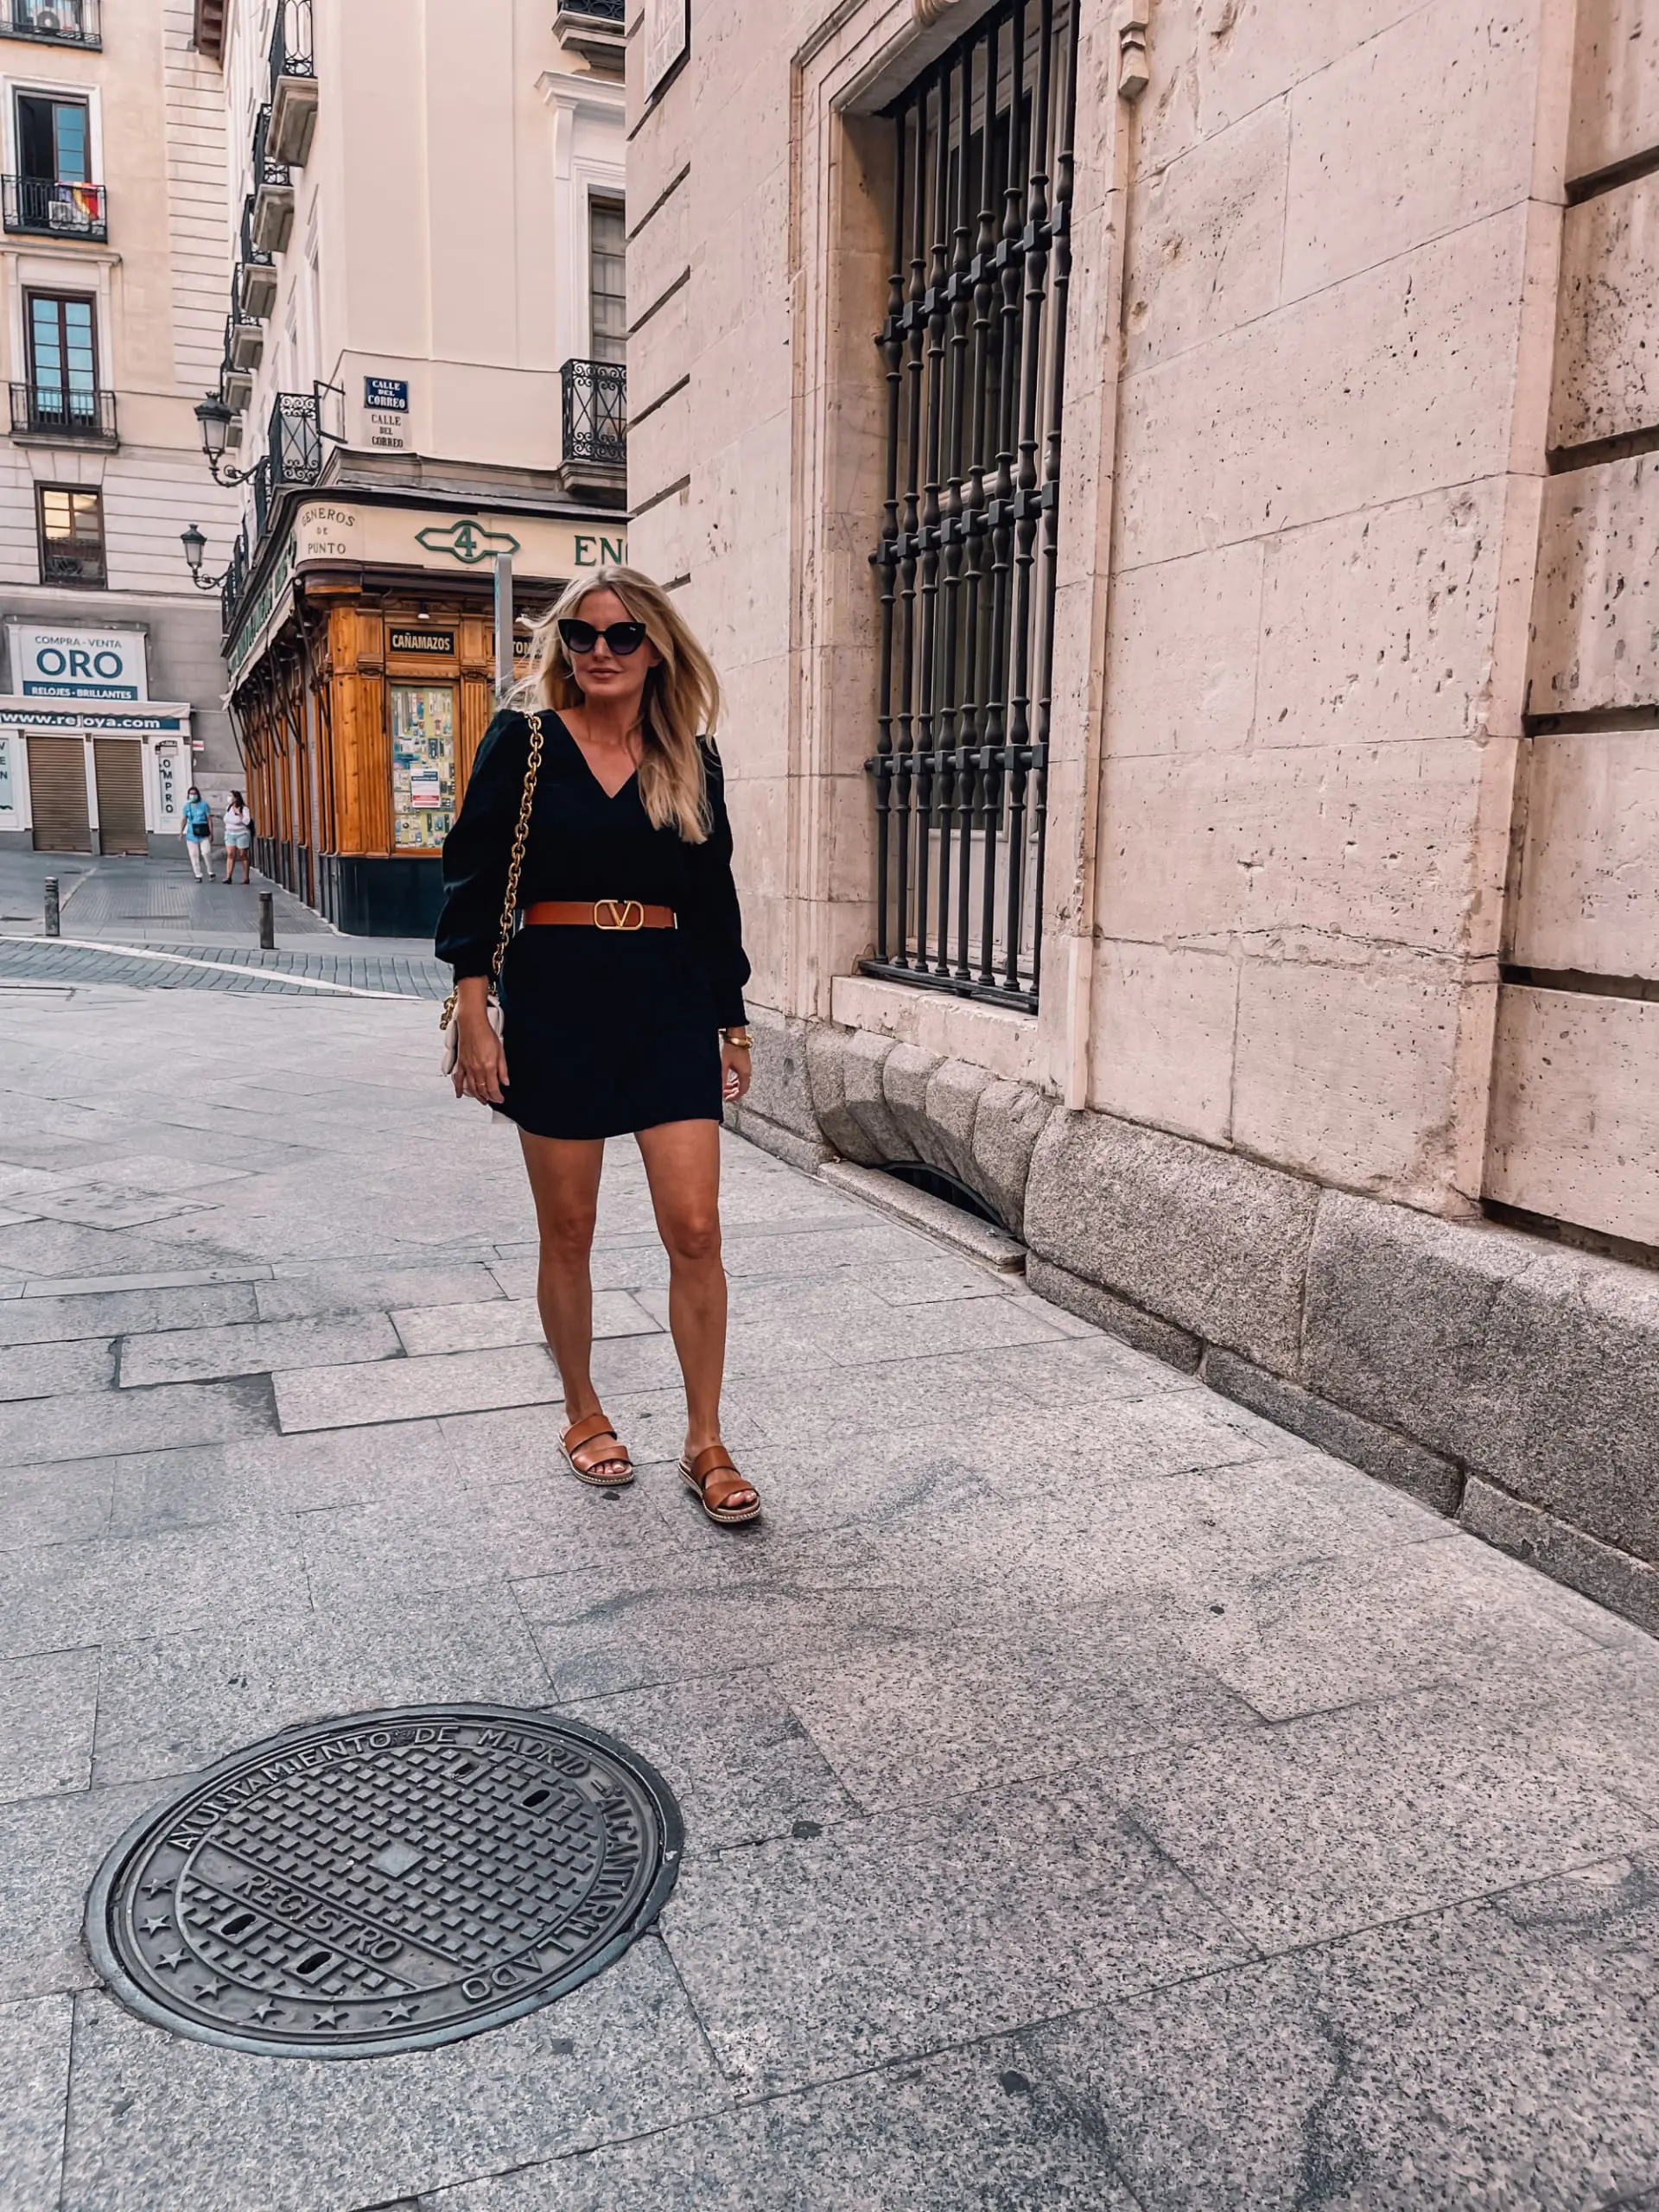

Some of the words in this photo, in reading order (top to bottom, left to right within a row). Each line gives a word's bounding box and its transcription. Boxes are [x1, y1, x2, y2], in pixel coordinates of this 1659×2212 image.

[372, 379, 401, 391] CALLE
[367, 395, 405, 409] CORREO
[372, 414, 401, 426] CALLE
[379, 426, 393, 435] DEL
[372, 435, 404, 448] CORREO
[316, 526, 328, 535] DE
[308, 543, 346, 555] PUNTO
[454, 525, 477, 556] 4
[574, 535, 626, 566] EN
[35, 635, 81, 646] COMPRA
[88, 639, 122, 648] VENTA
[392, 632, 450, 651] CAÑAMAZOS
[36, 648, 123, 679] ORO
[31, 686, 71, 696] RELOJES
[77, 689, 131, 700] BRILLANTES
[0, 712, 161, 729] www.rejoya.com
[413, 1726, 459, 1745] DE
[477, 1729, 591, 1778] MADRID
[167, 1731, 391, 1851] AYUNTAMIENTO
[462, 1797, 640, 2004] ALCANTARILLADO
[232, 1874, 404, 1962] REGISTRO
